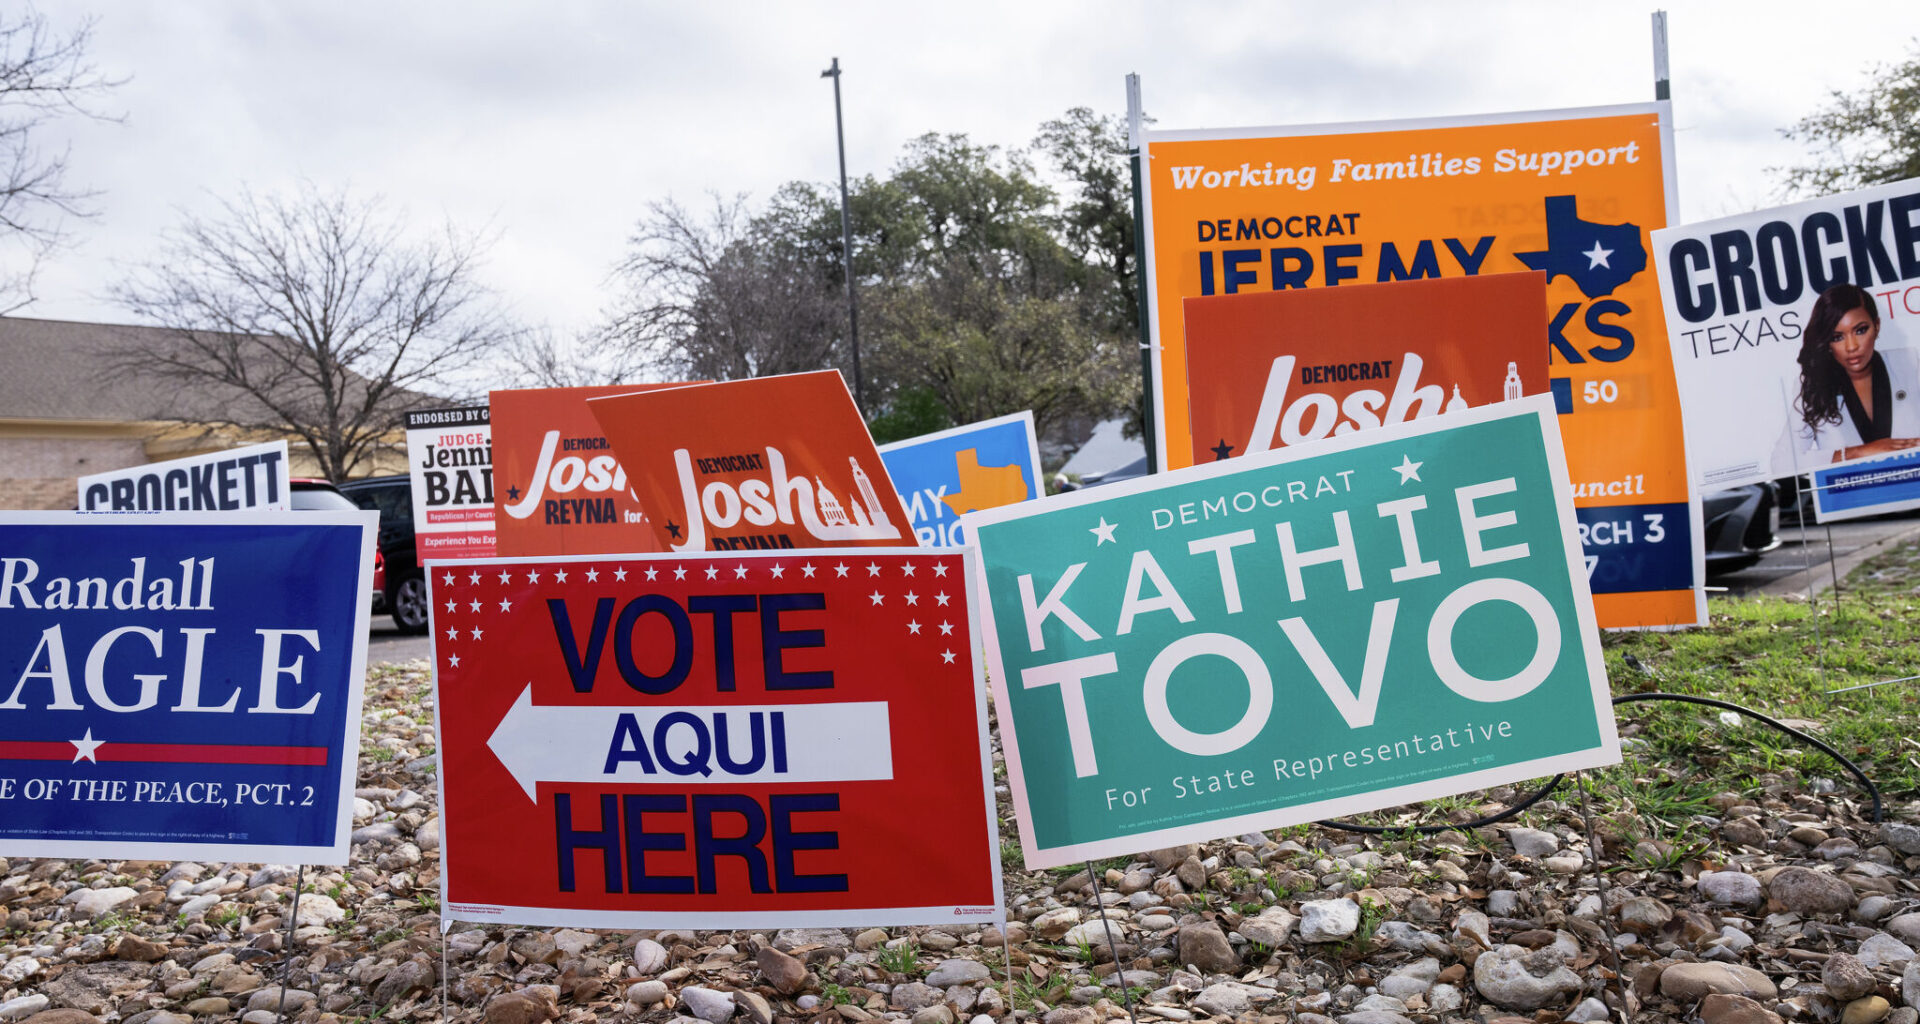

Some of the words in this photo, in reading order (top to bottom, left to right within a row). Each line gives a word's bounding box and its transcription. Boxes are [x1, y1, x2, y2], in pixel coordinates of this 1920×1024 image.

[1170, 162, 1317, 191] Working
[1329, 153, 1482, 183] Families
[1493, 140, 1640, 177] Support
[1197, 213, 1360, 242] DEMOCRAT
[1669, 193, 1920, 323] CROCKE
[1681, 311, 1802, 359] TEXAS
[1301, 360, 1392, 385] DEMOCRAT
[1583, 379, 1618, 404] 50
[410, 412, 463, 425] ENDORSED
[466, 410, 479, 421] BY
[438, 433, 484, 447] JUDGE
[563, 437, 610, 451] DEMOCR
[696, 453, 764, 474] DEMOCRAT
[430, 512, 464, 522] Republican
[465, 512, 474, 521] for
[474, 511, 493, 519] Court
[545, 498, 617, 525] REYNA
[624, 509, 642, 523] for
[669, 446, 820, 551] Josh
[1151, 470, 1357, 531] DEMOCRAT
[425, 536, 466, 547] Experience
[467, 536, 481, 545] You
[1643, 513, 1665, 543] 3
[0, 557, 215, 611] Randall
[1017, 477, 1532, 653] KATHIE
[546, 592, 835, 695] VOTE
[0, 623, 322, 715] AGLE
[1020, 577, 1562, 779] TOVO
[603, 711, 788, 778] AQUI
[1106, 787, 1153, 811] For
[1172, 767, 1255, 799] State
[1272, 721, 1512, 782] Representative
[24, 778, 62, 800] OF
[68, 779, 127, 802] THE
[133, 781, 228, 808] PEACE,
[234, 783, 295, 806] PCT.
[300, 785, 314, 806] 2
[554, 792, 849, 895] HERE
